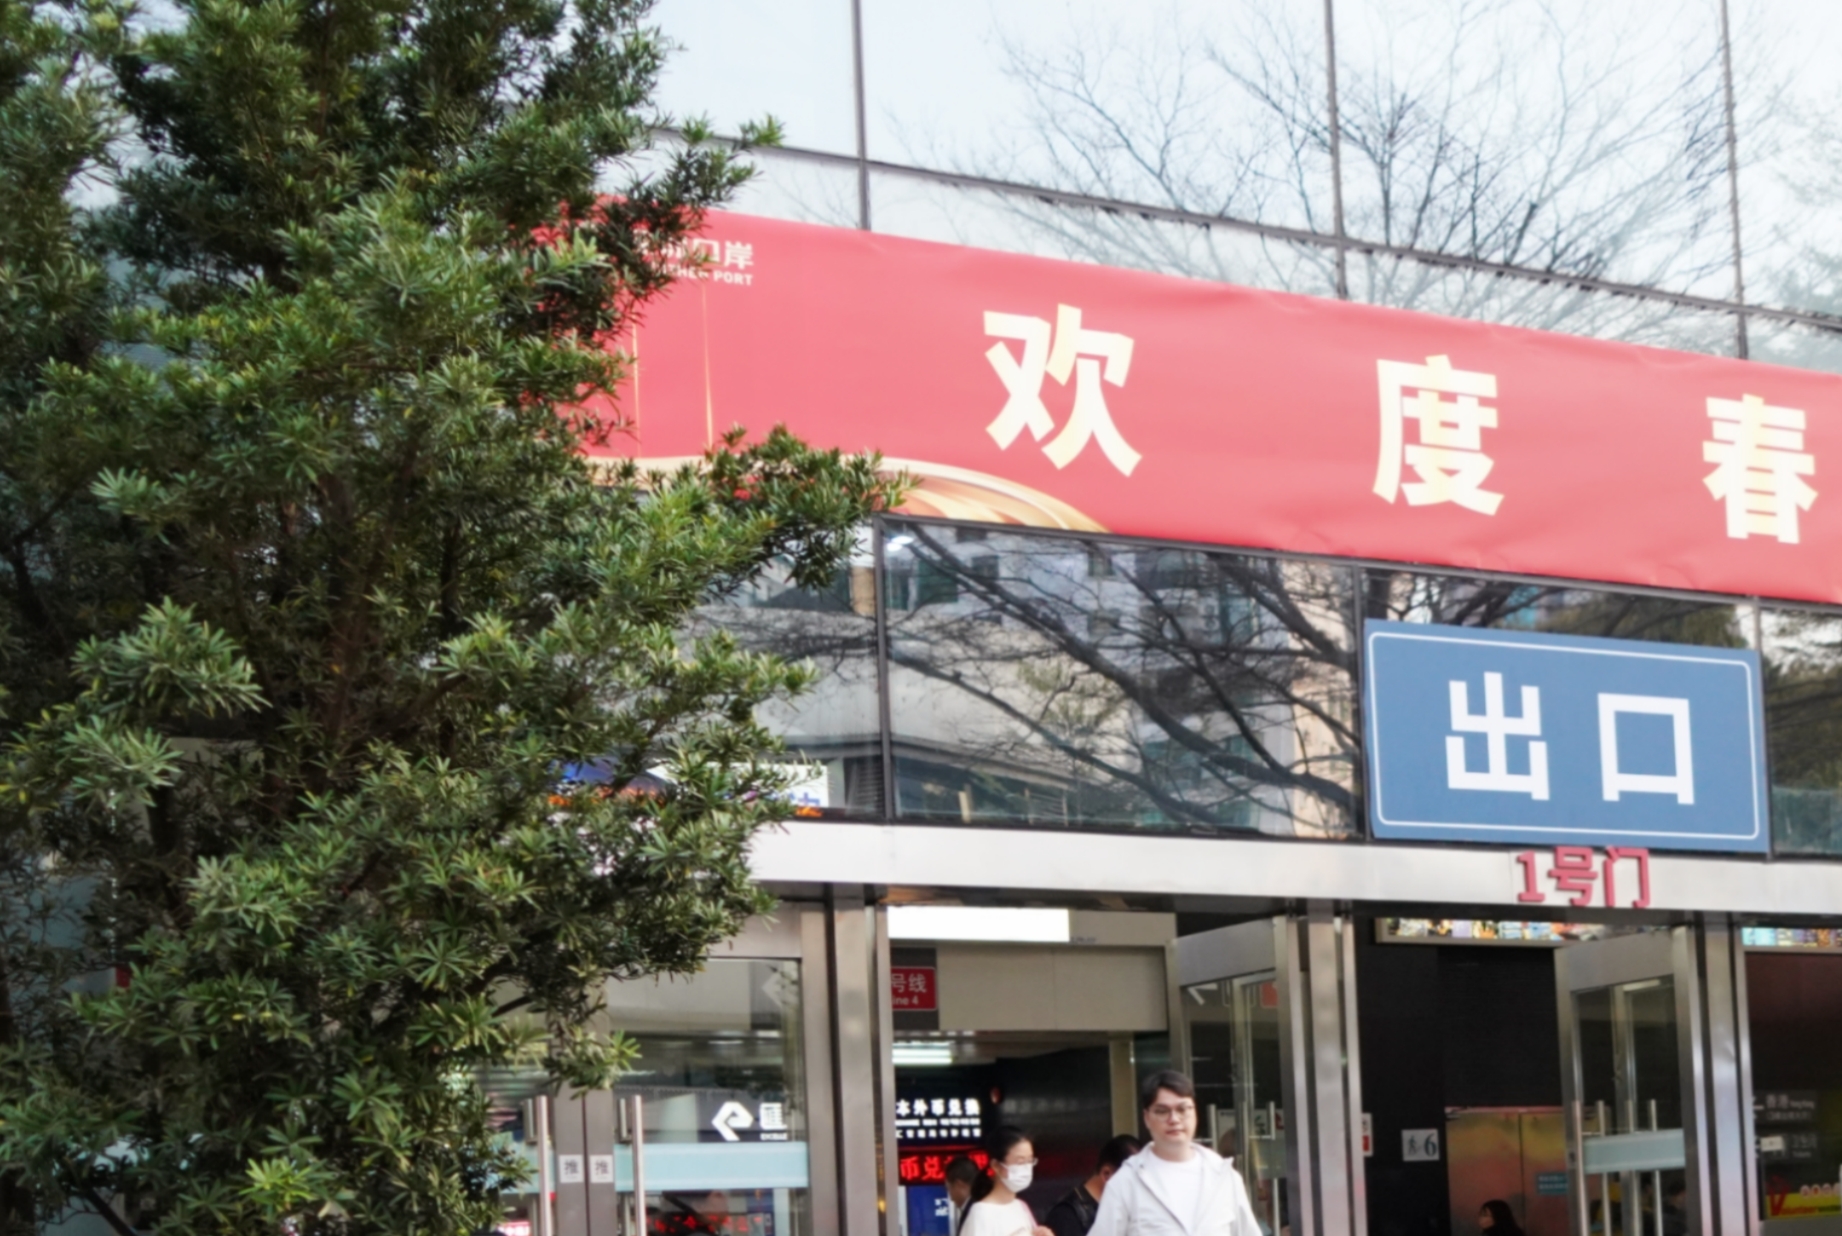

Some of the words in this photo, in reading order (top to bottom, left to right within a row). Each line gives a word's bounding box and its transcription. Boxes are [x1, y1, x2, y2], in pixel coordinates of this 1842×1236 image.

[713, 269, 753, 286] PORT
[1446, 671, 1695, 805] 出口
[1516, 847, 1650, 908] 1号门
